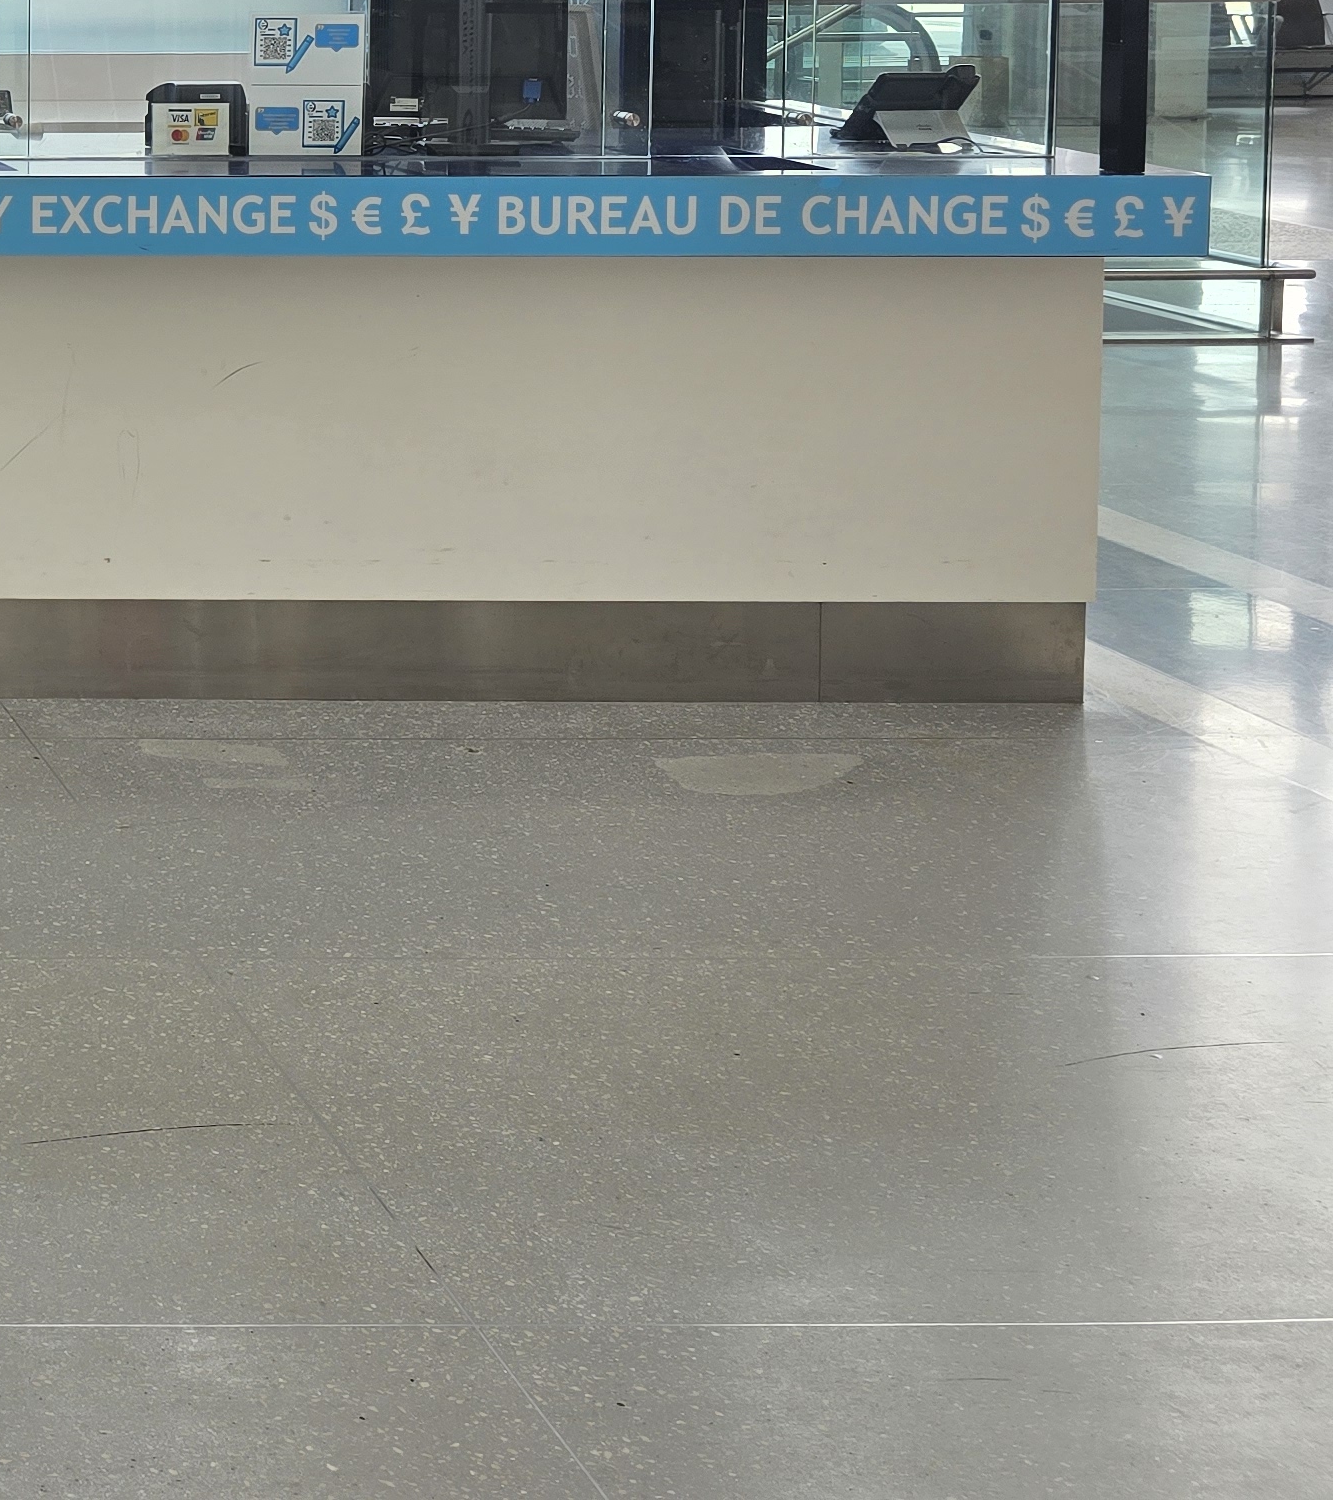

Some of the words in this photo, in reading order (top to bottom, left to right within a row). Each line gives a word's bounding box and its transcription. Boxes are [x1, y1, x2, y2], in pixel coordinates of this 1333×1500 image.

[171, 113, 190, 123] VISA
[29, 193, 298, 237] EXCHANGE
[308, 190, 339, 242] $
[350, 195, 383, 237] €
[400, 192, 431, 237] £
[448, 193, 481, 236] ¥
[496, 193, 700, 237] BUREAU
[718, 192, 785, 237] DE
[798, 192, 1010, 238] CHANGE
[1019, 193, 1052, 244] $
[1062, 197, 1097, 240] €
[1113, 194, 1146, 240] £
[1162, 194, 1198, 239] ¥
